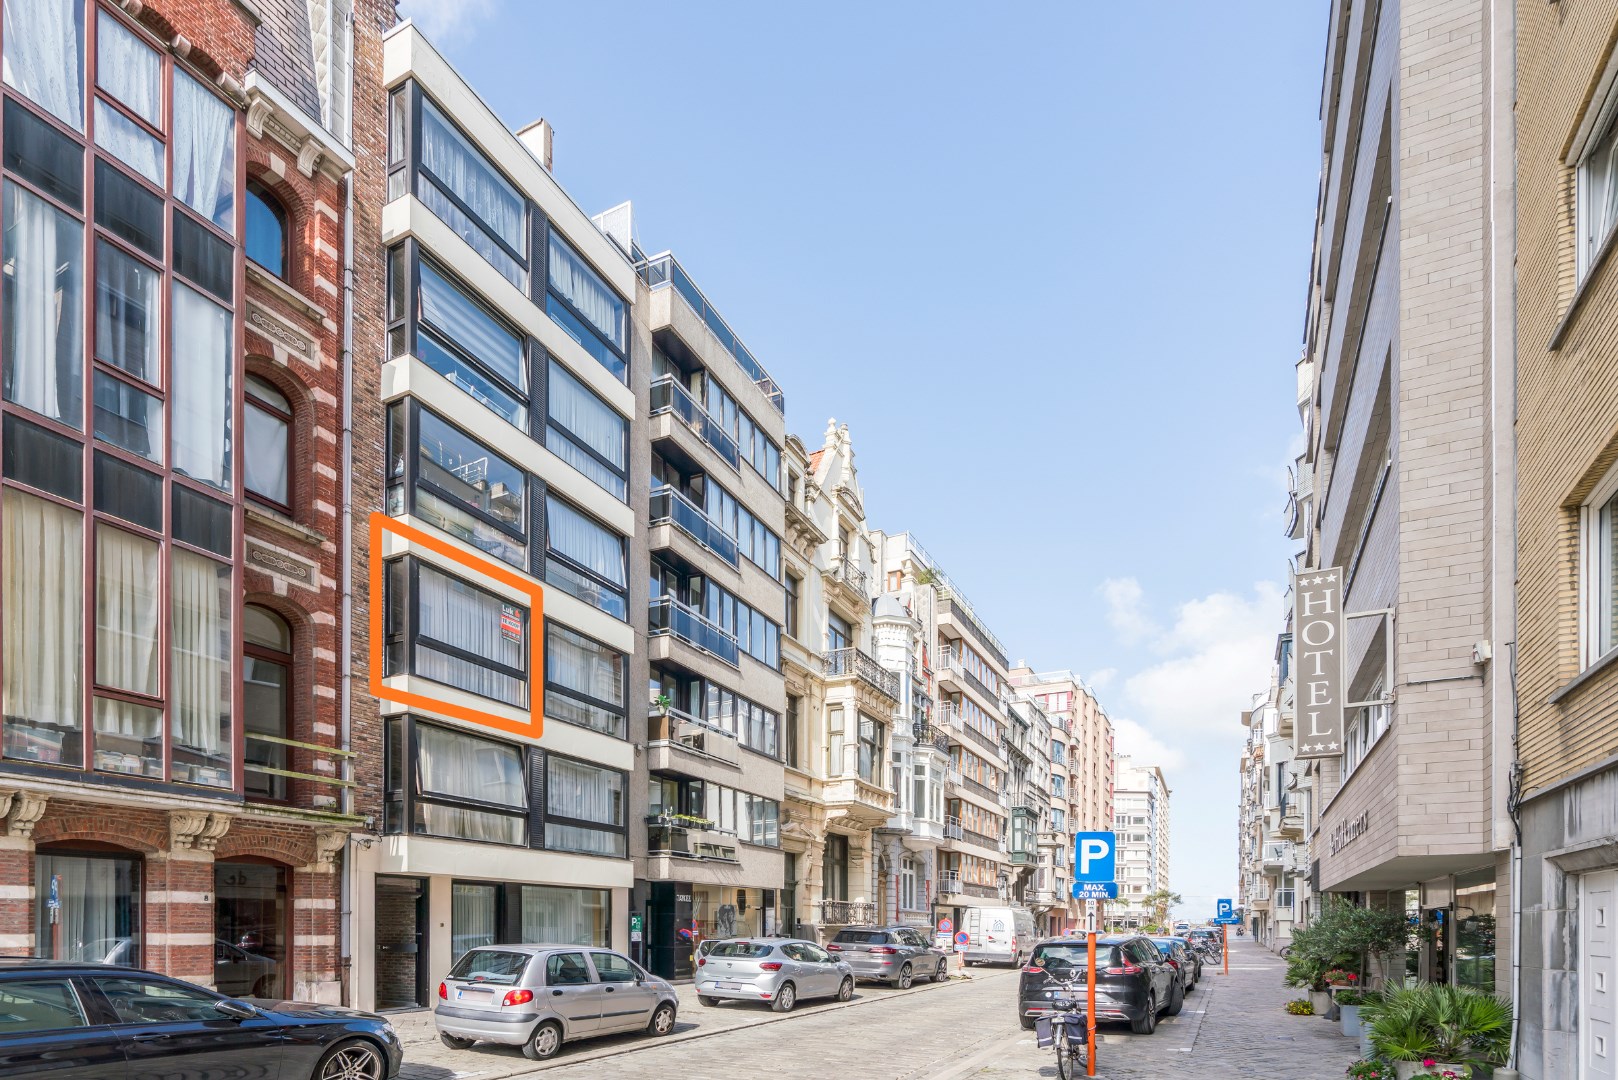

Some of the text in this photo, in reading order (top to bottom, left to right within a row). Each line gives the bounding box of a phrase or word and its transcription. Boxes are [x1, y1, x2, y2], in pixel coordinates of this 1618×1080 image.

[502, 604, 514, 615] Luk
[1301, 588, 1335, 737] HOTEL
[1081, 839, 1110, 874] P
[1083, 883, 1107, 891] MAX.
[1219, 903, 1230, 915] P
[631, 917, 638, 927] P
